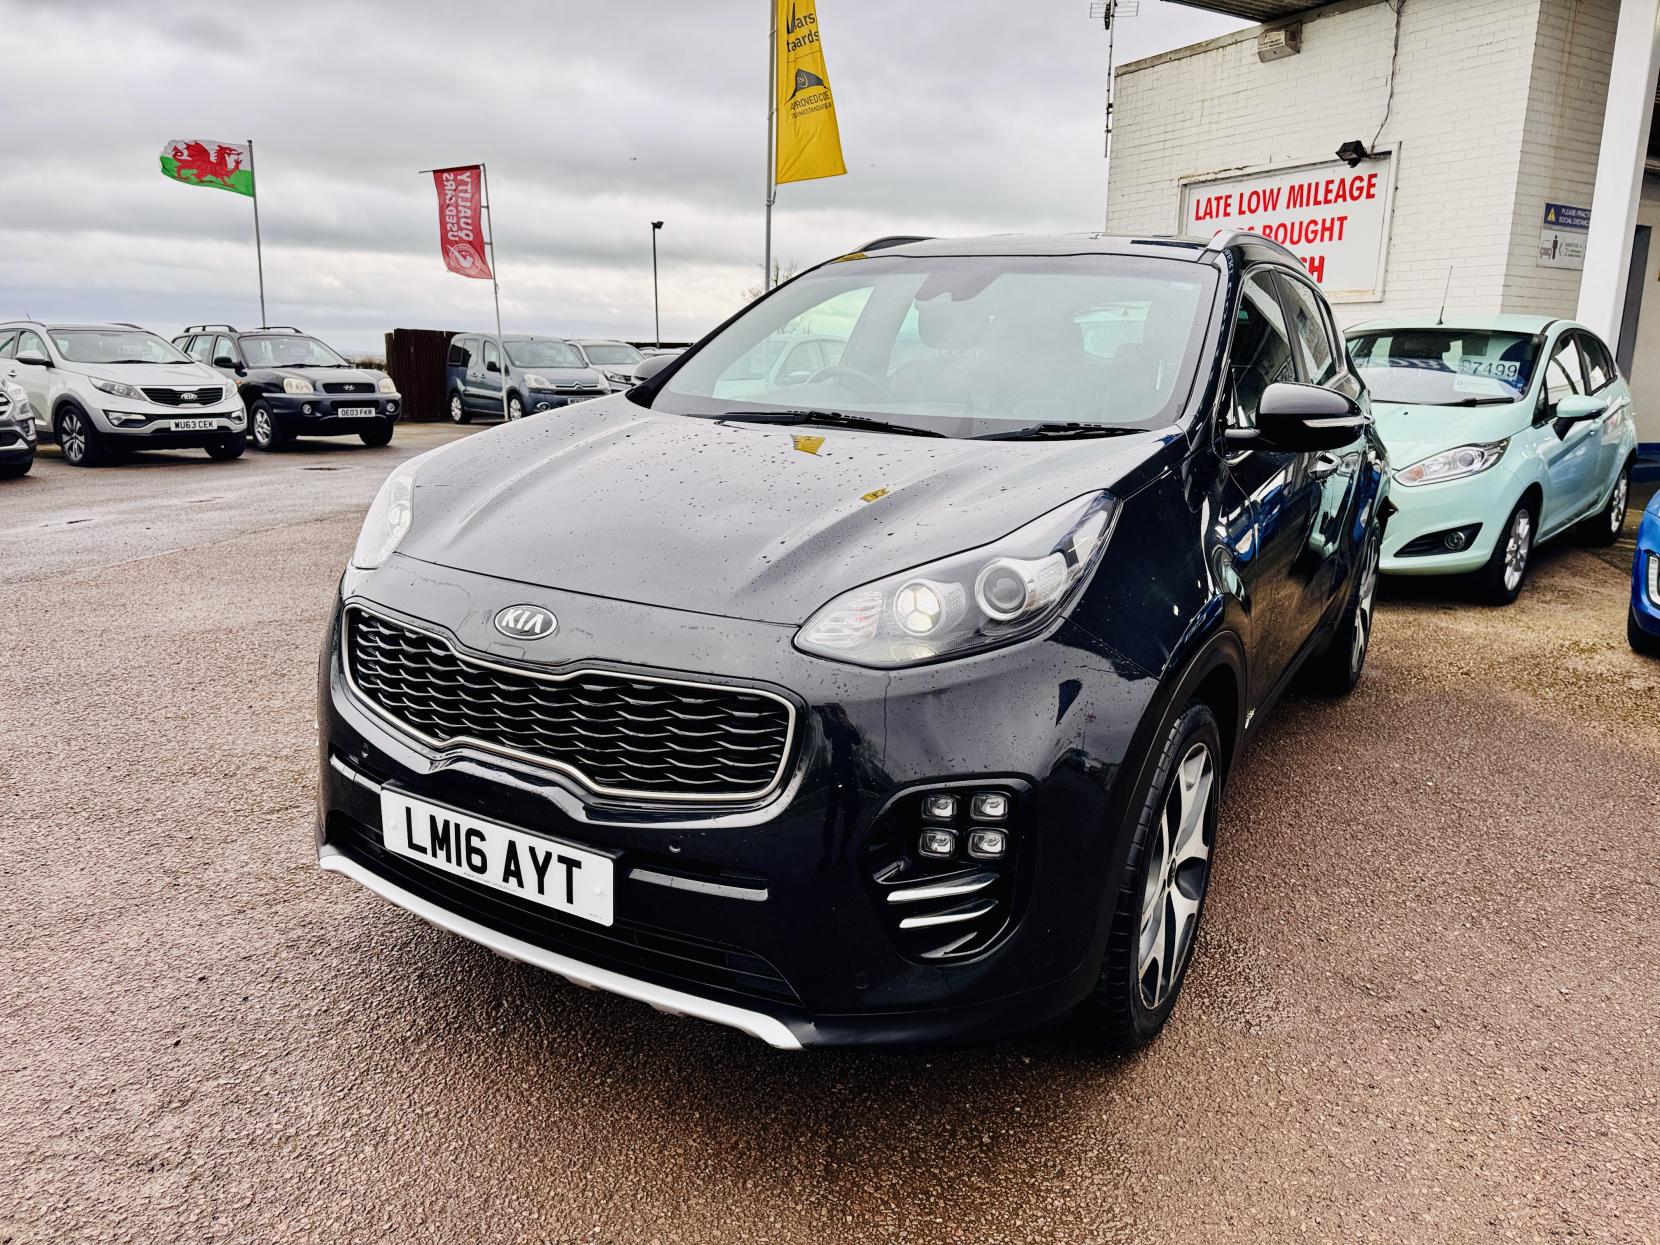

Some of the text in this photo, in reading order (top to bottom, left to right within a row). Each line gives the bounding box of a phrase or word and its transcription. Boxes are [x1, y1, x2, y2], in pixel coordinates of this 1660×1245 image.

[1194, 172, 1378, 221] LATE LOW MILEAGE
[1262, 215, 1348, 246] BOUGHT
[198, 420, 214, 429] CEK
[501, 609, 545, 634] KIA
[405, 806, 582, 905] LM16 AYT
